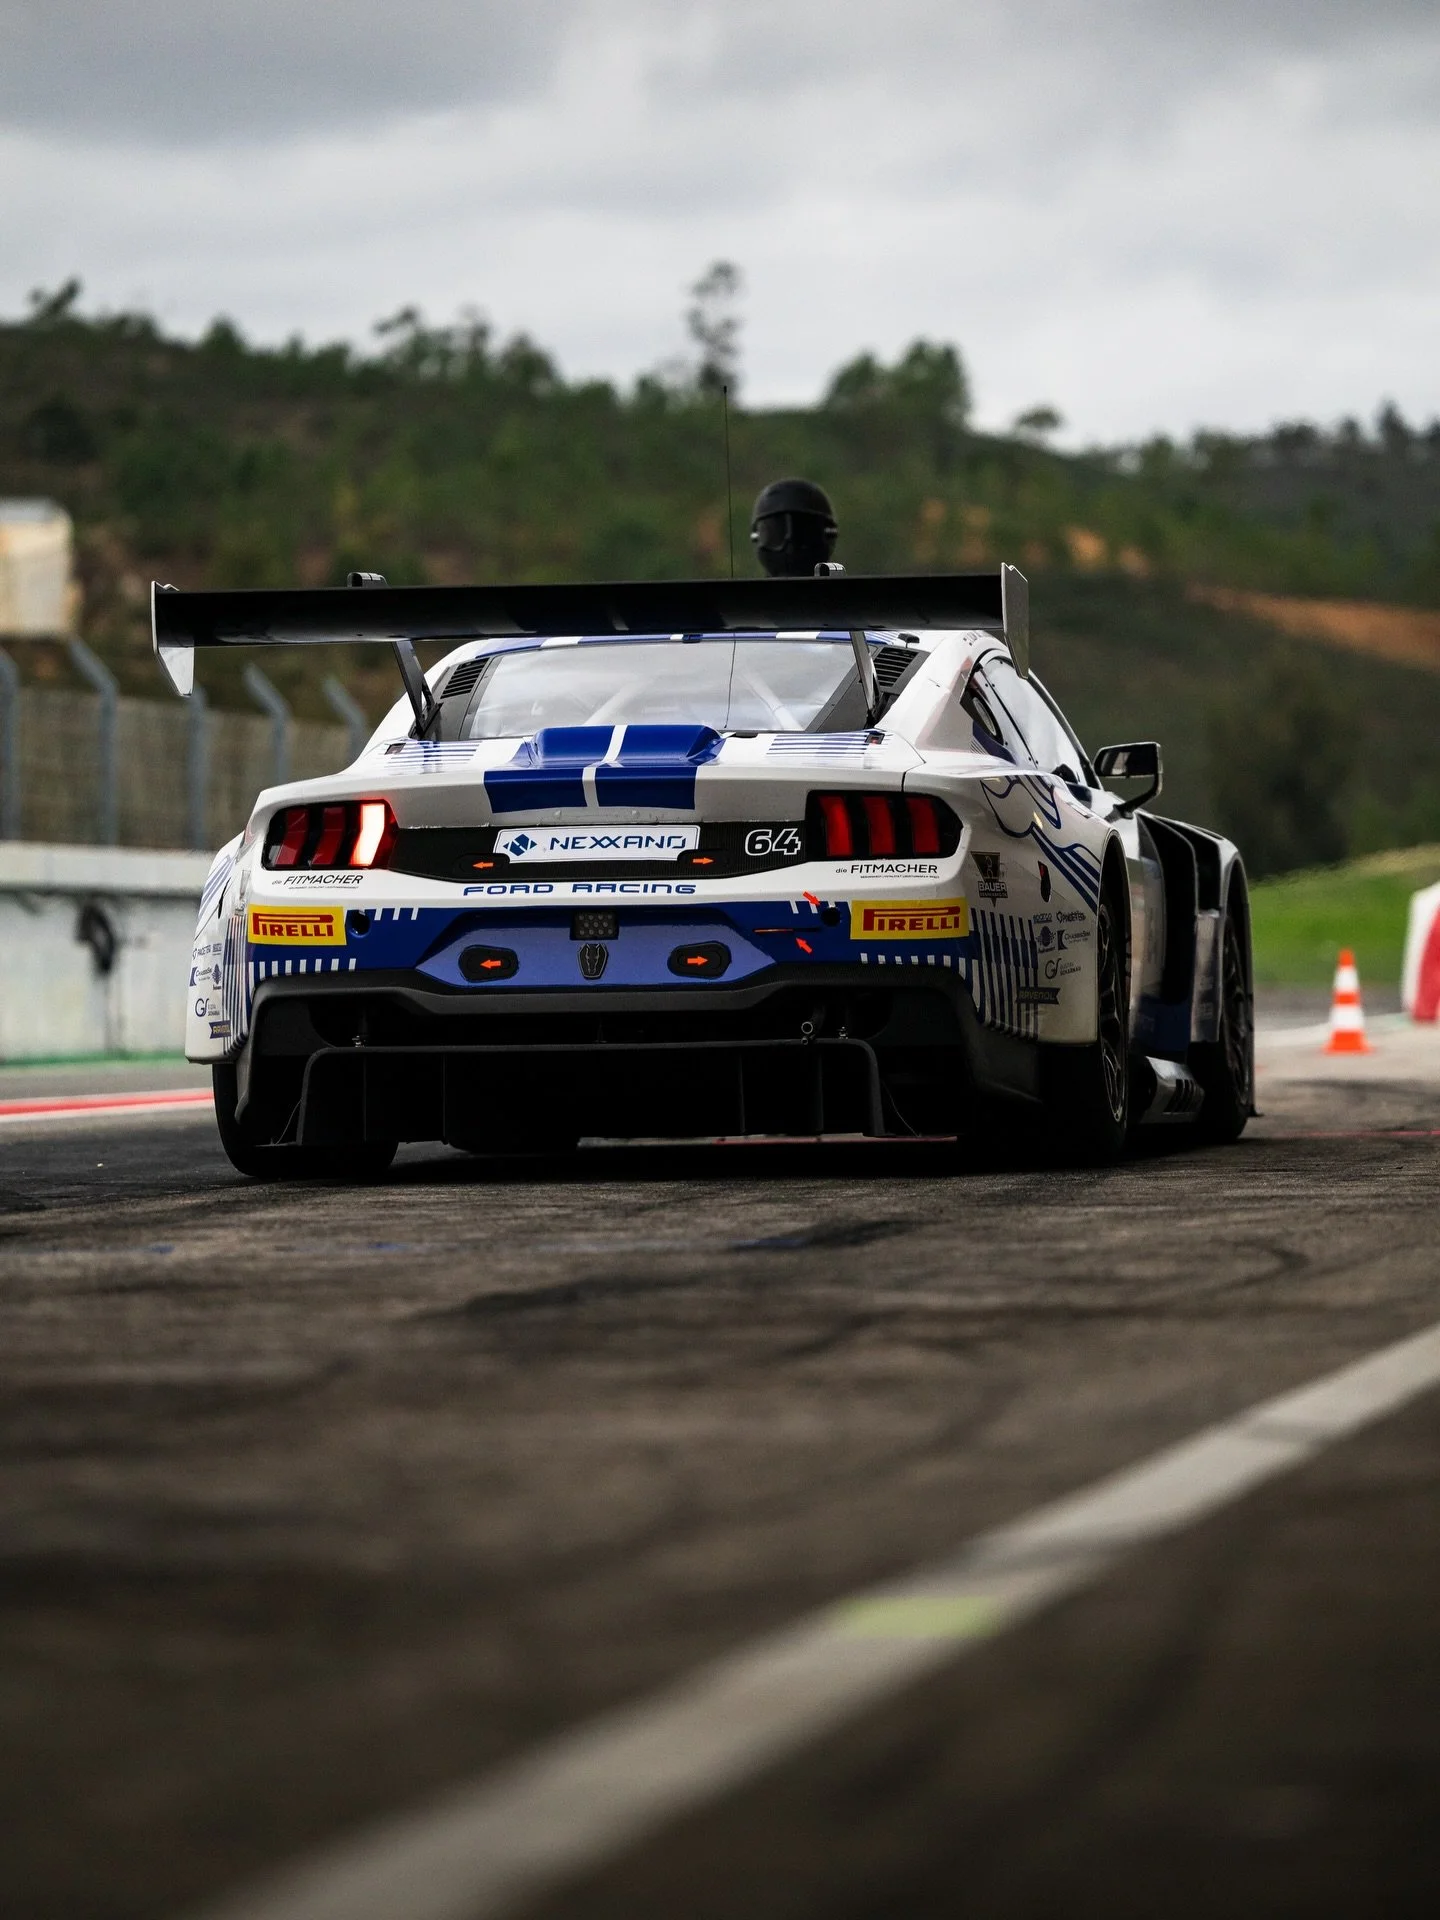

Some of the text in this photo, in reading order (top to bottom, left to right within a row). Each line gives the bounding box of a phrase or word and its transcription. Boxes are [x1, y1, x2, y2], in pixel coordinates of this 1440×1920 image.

[549, 835, 687, 851] NEXXANO
[744, 828, 802, 857] 64
[850, 863, 938, 874] FITMACHER
[283, 874, 364, 885] FITMACHER
[463, 883, 697, 896] FORD RACING
[979, 881, 1008, 893] BAUER
[252, 912, 334, 937] PIRELLI
[862, 905, 961, 931] PIRELLI
